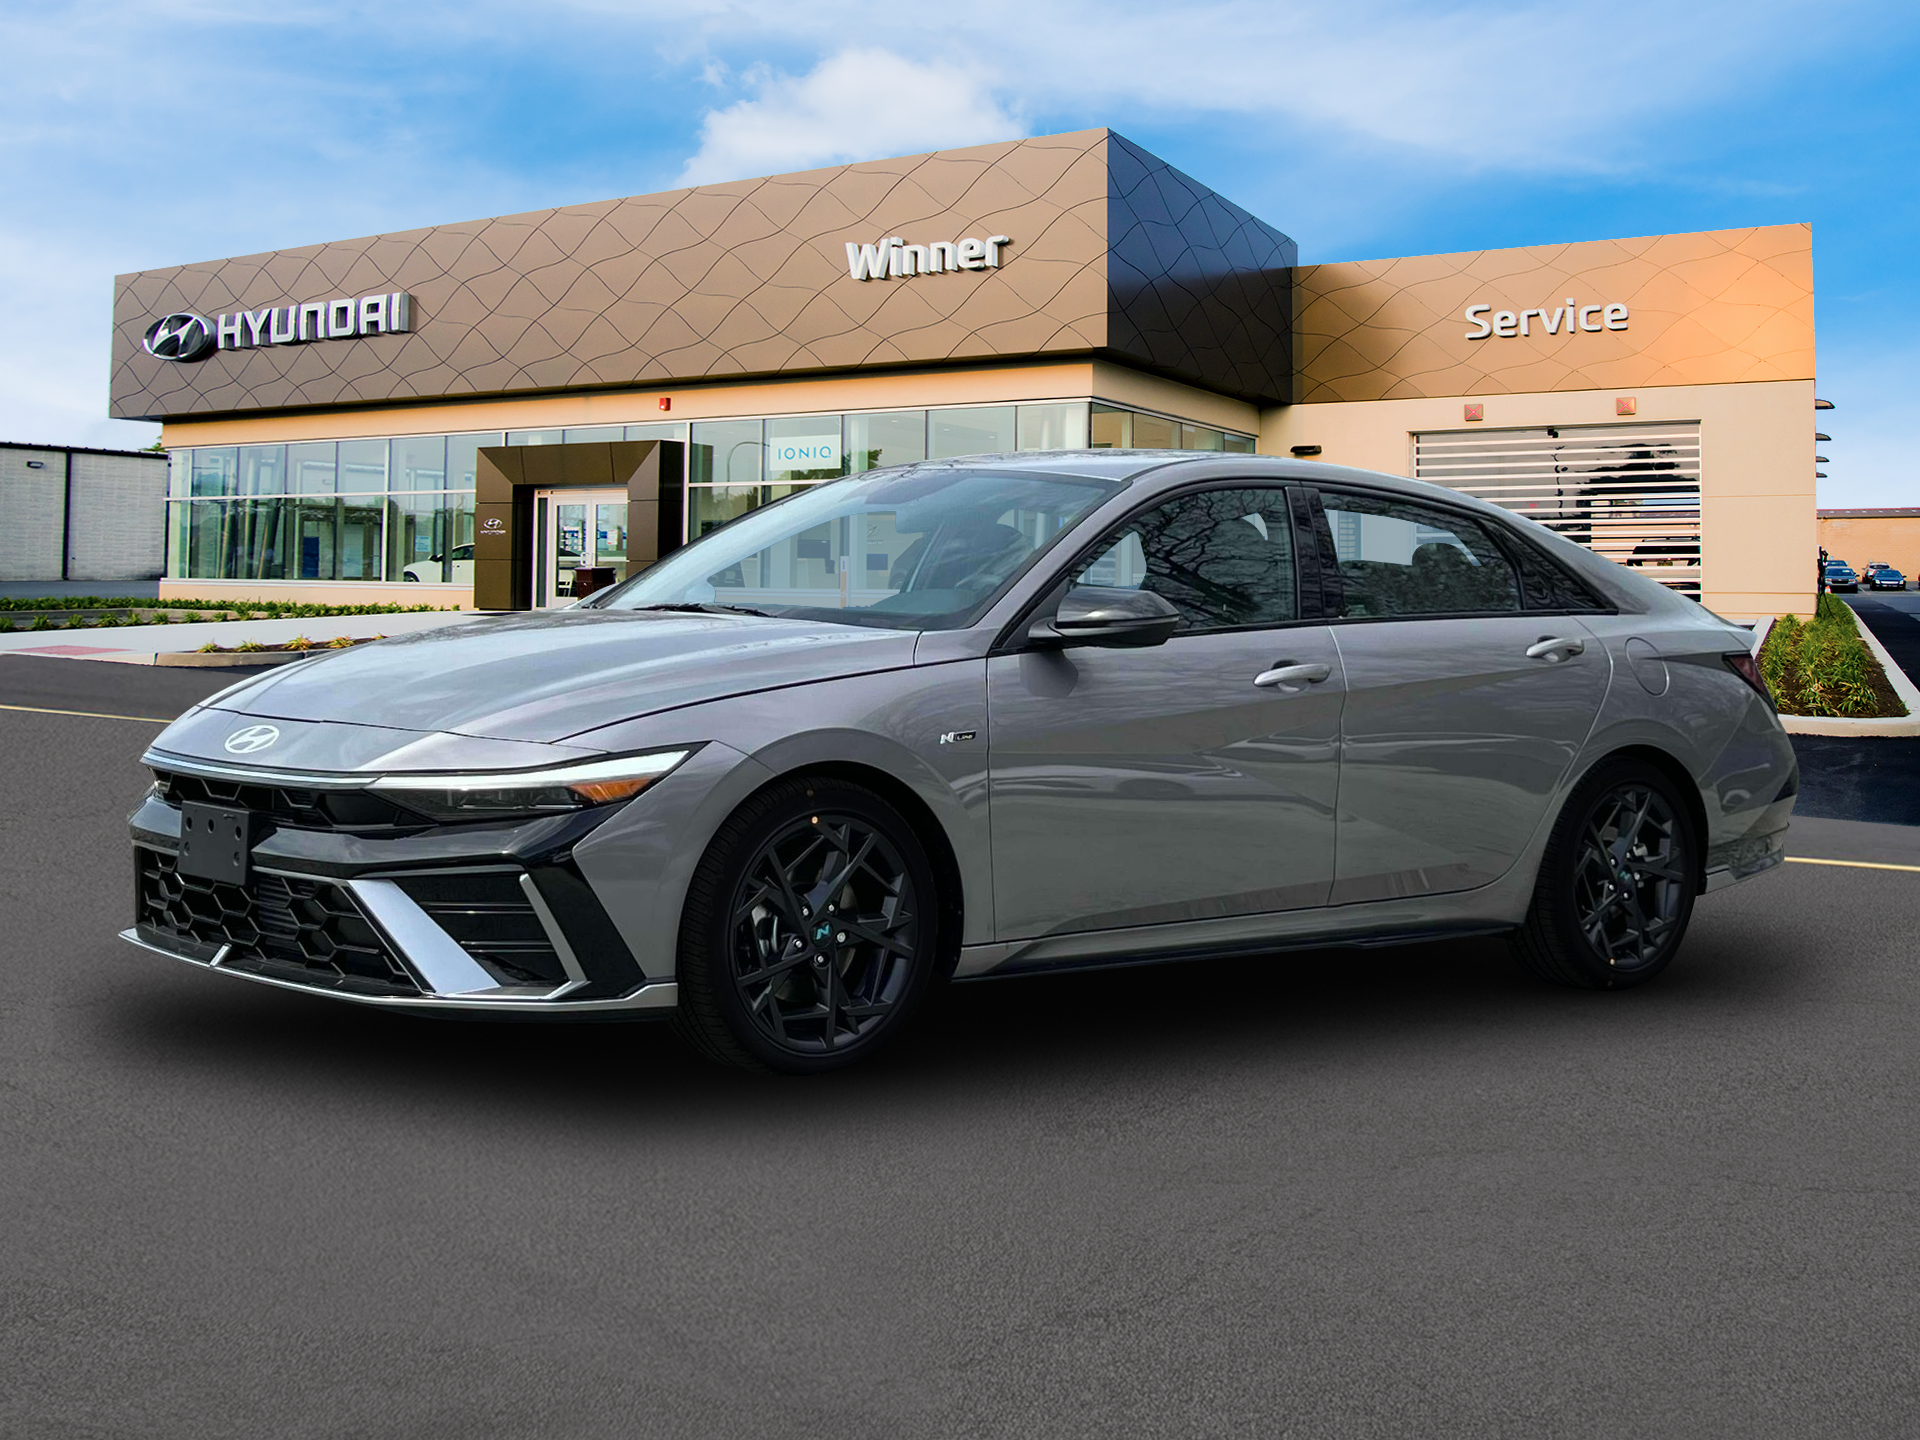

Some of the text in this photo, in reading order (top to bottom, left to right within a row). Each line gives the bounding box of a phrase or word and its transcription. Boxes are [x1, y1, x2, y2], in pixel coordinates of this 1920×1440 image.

[845, 235, 1010, 281] Winner
[216, 292, 409, 349] HYUNDAI
[1464, 297, 1629, 340] Service
[778, 446, 832, 460] IONIQ
